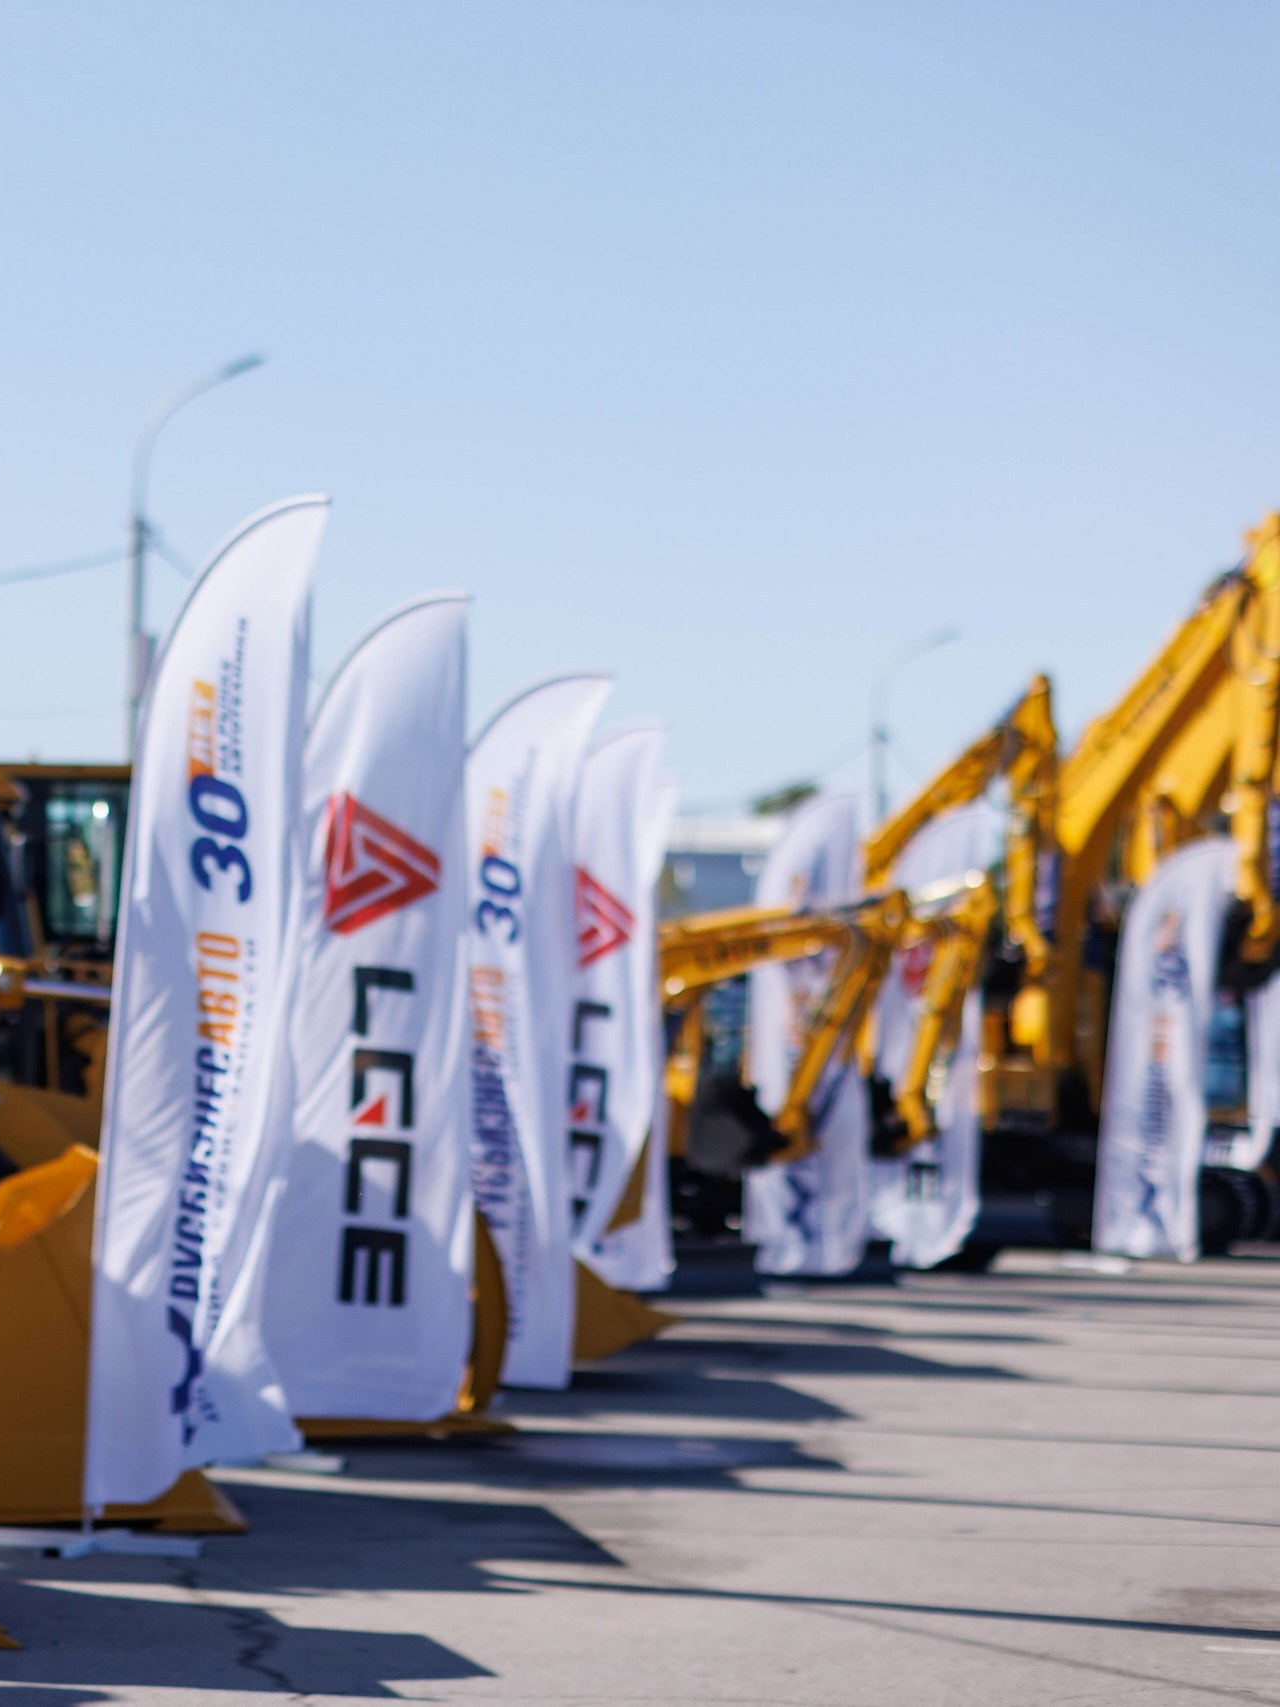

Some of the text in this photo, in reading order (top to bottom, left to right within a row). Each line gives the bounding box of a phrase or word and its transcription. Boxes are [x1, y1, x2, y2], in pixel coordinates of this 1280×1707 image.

[187, 774, 253, 904] 30
[477, 855, 522, 943] 30
[336, 966, 415, 1308] LGCE
